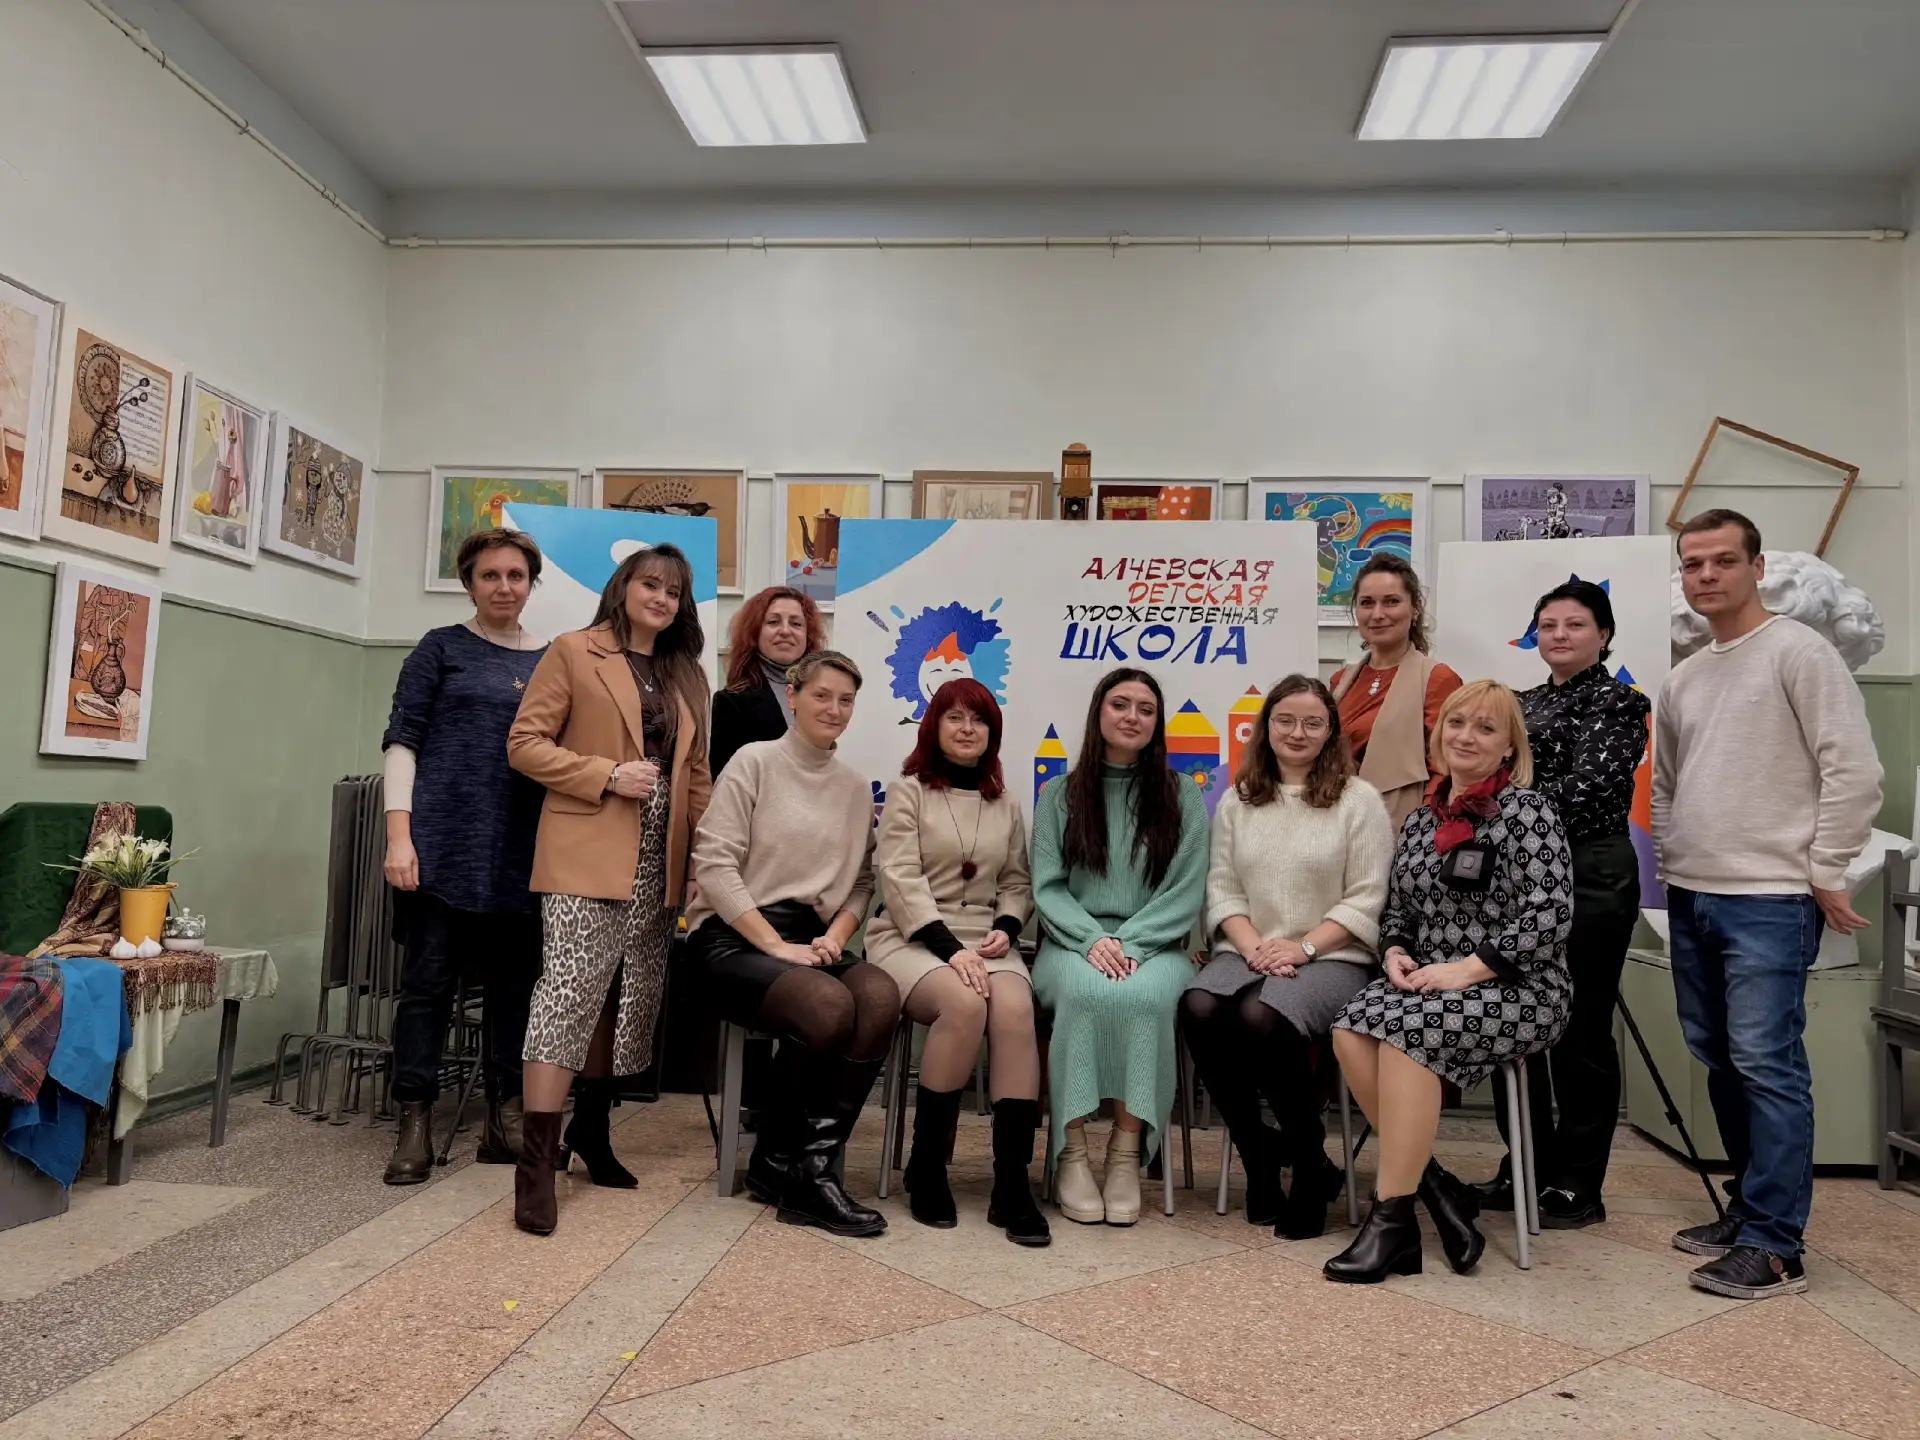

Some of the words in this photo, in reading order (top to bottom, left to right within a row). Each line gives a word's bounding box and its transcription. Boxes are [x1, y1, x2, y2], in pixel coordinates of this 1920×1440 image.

[1081, 557, 1274, 582] АЛЧЕВСКАЯ
[1128, 581, 1268, 606] ДЕТСКАЯ
[1063, 604, 1279, 625] ХУДОЖЕСТВЕННАЯ
[1059, 622, 1247, 664] ШКОЛА
